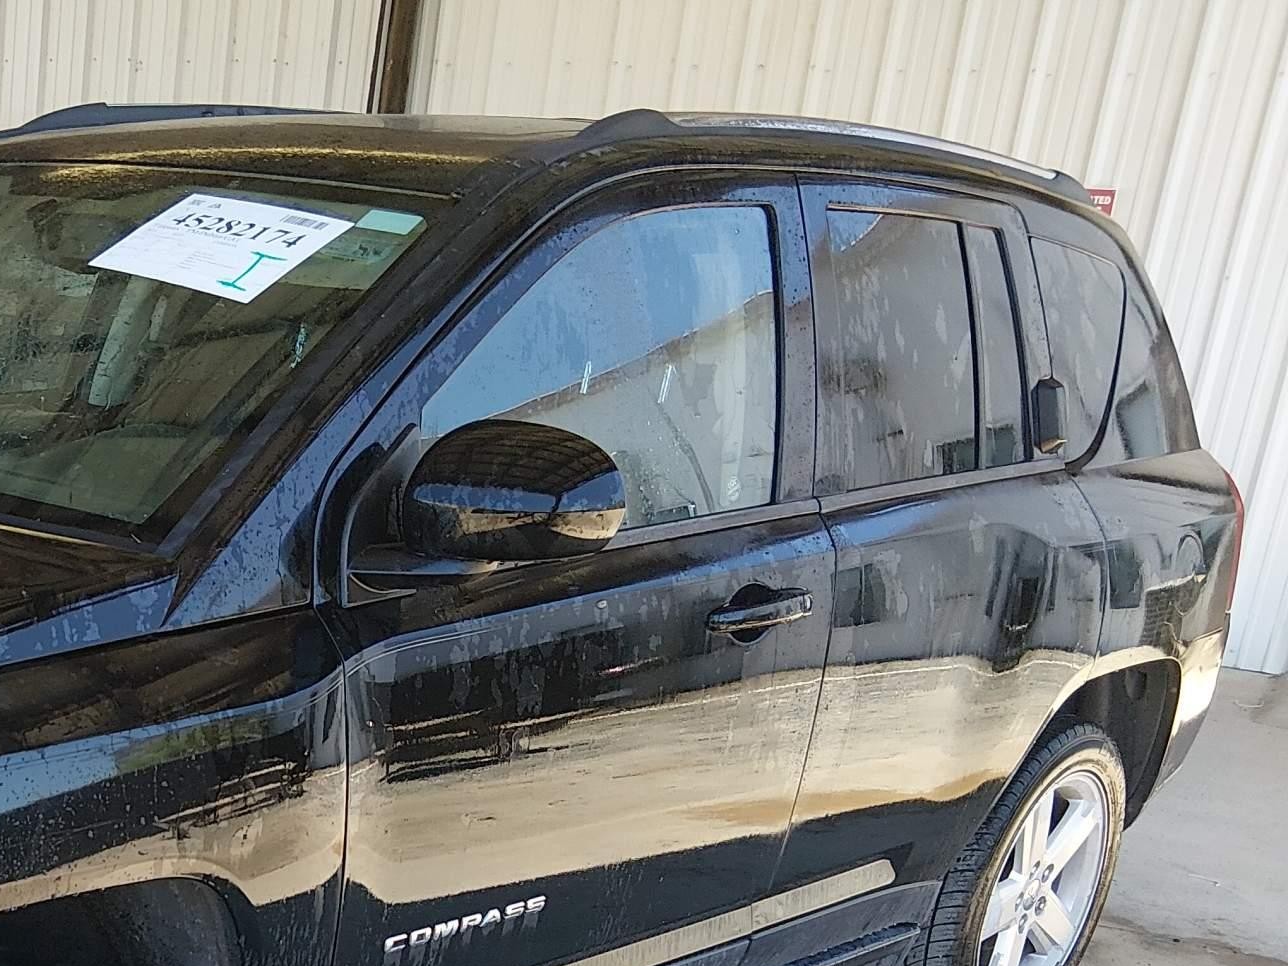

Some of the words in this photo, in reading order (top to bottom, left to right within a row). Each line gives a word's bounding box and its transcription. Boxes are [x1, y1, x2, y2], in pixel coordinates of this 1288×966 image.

[1090, 195, 1112, 205] TED
[172, 212, 308, 248] 45282174
[383, 895, 547, 953] COMPASS
